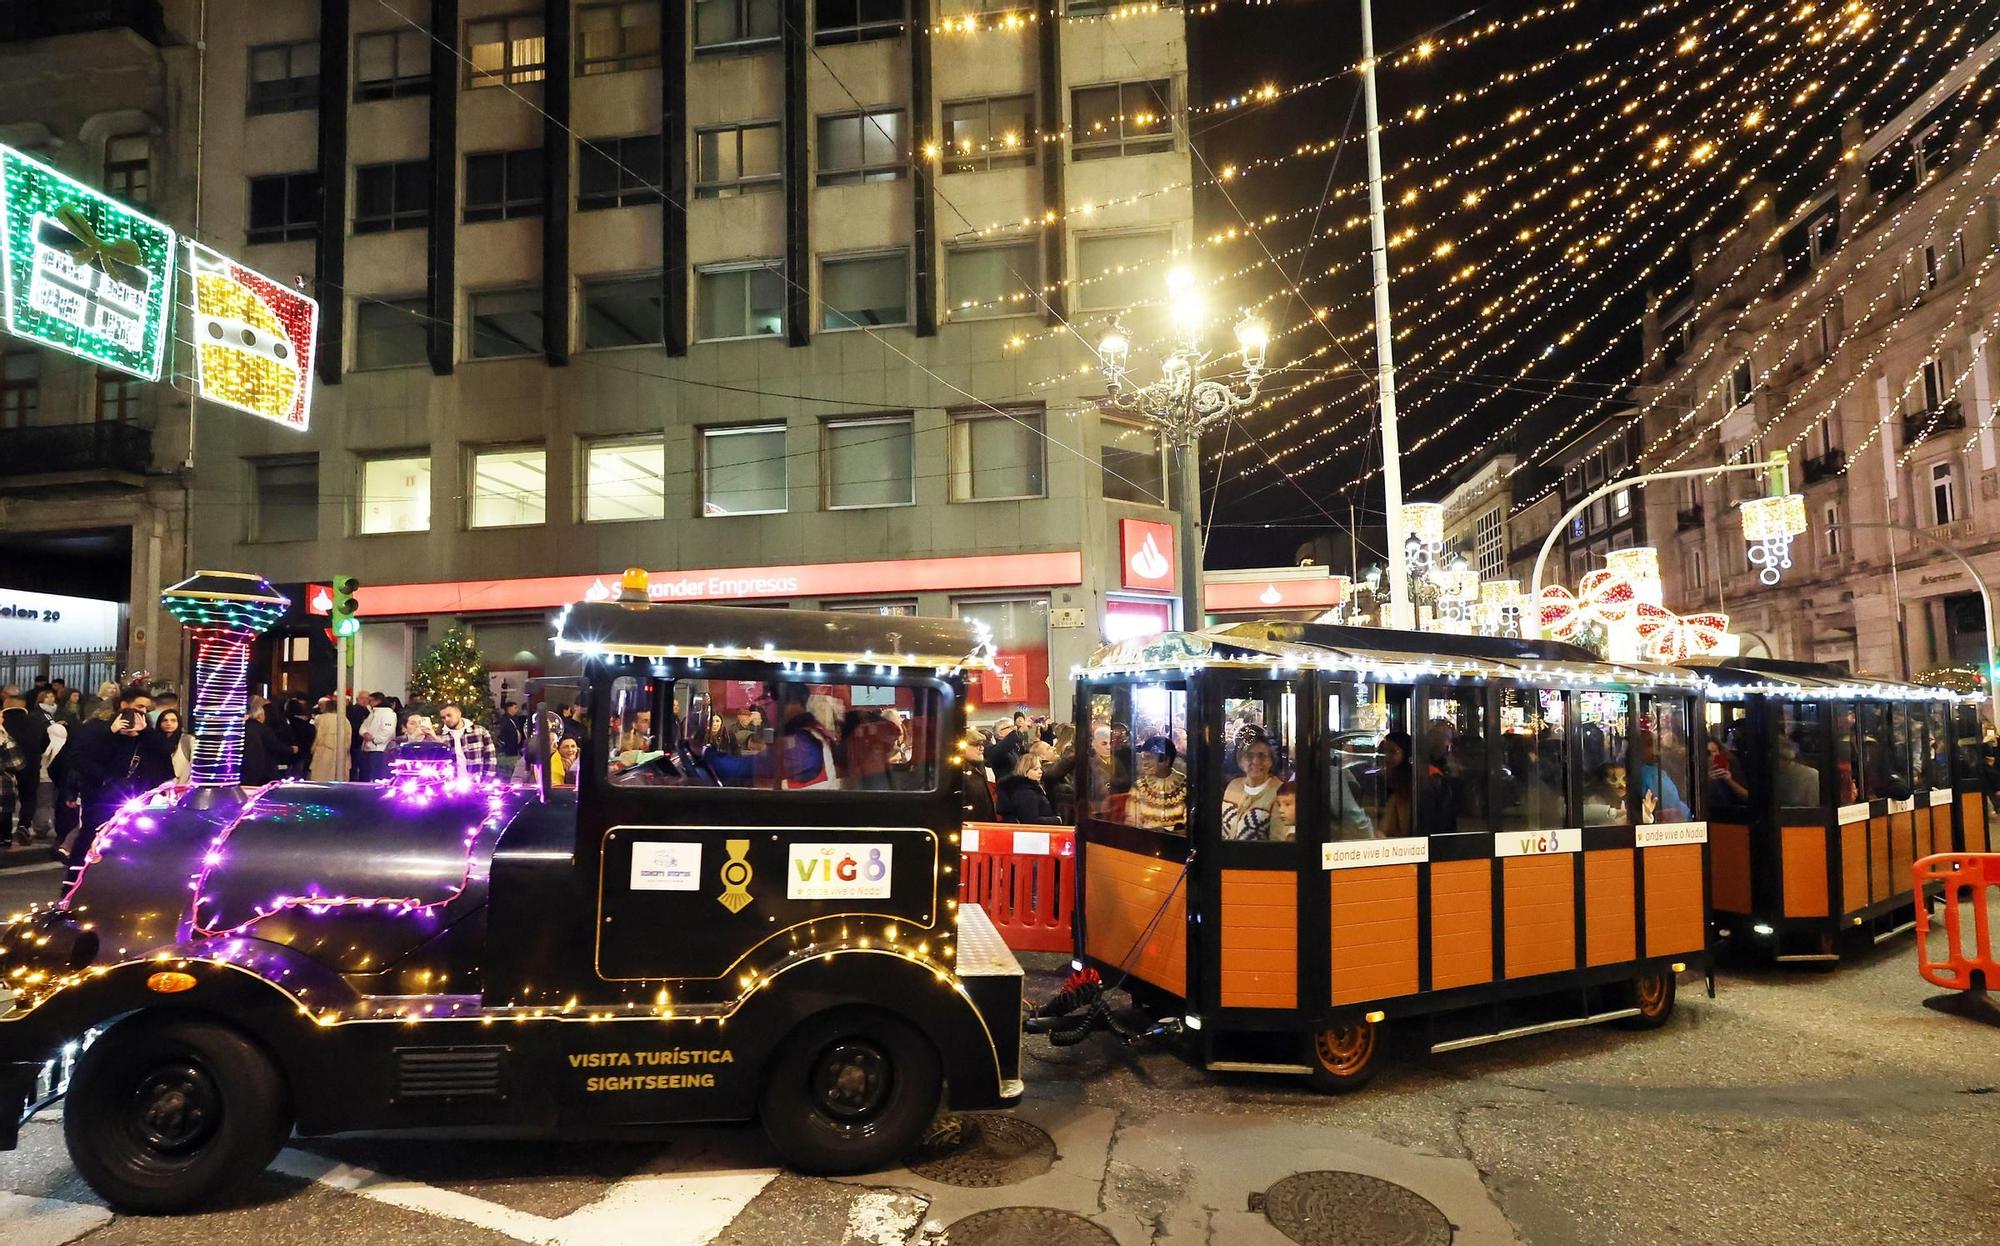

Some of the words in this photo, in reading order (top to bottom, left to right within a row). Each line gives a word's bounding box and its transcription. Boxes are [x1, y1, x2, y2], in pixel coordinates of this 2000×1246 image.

[611, 578, 705, 600] Sander
[709, 577, 798, 597] Empresas
[43, 610, 60, 622] 20
[1645, 829, 1663, 841] onde
[1665, 830, 1678, 840] vive
[1685, 826, 1705, 839] Nadal
[1333, 848, 1361, 862] donde
[1363, 848, 1380, 859] vive
[1382, 846, 1390, 858] la
[1392, 844, 1426, 857] Navidad
[568, 1052, 631, 1067] VISITA
[634, 1047, 733, 1066] TURÍSTICA
[586, 1074, 715, 1091] SIGHTSEEING
